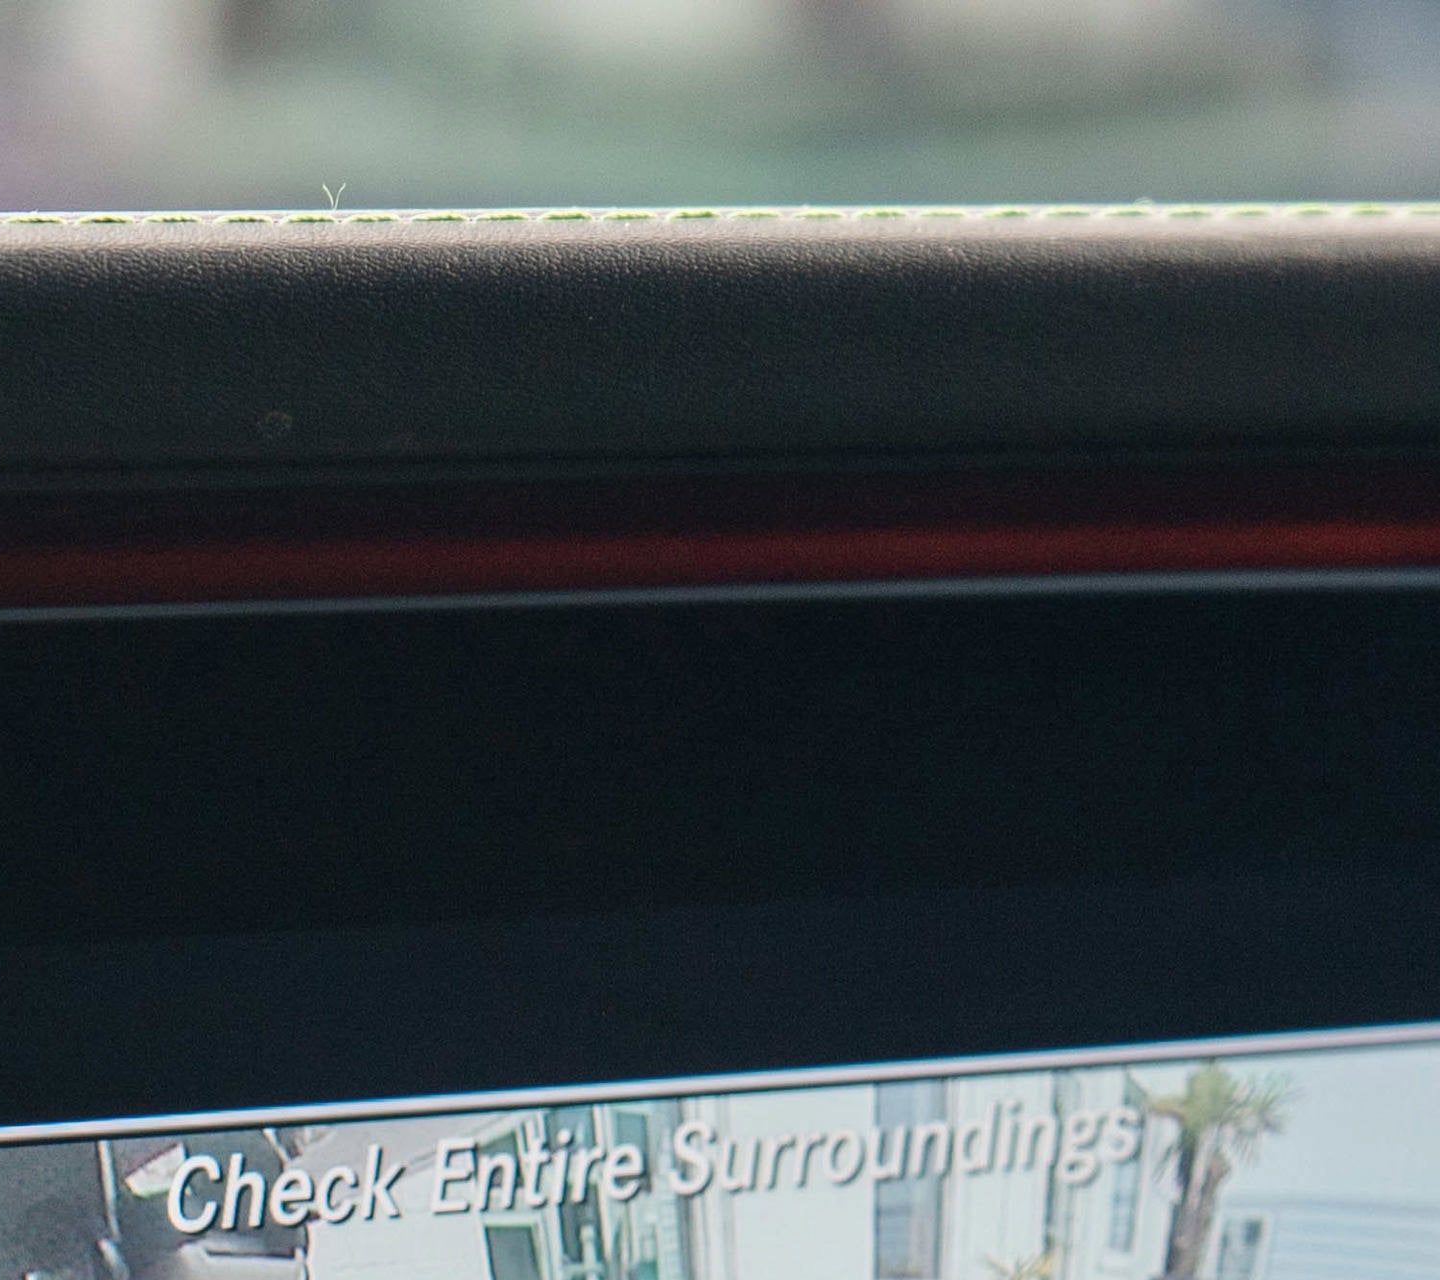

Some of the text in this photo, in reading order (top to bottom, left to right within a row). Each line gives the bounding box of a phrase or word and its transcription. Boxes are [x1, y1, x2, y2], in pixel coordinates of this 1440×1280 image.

[165, 1099, 1142, 1235] Check Entire Surroundings
